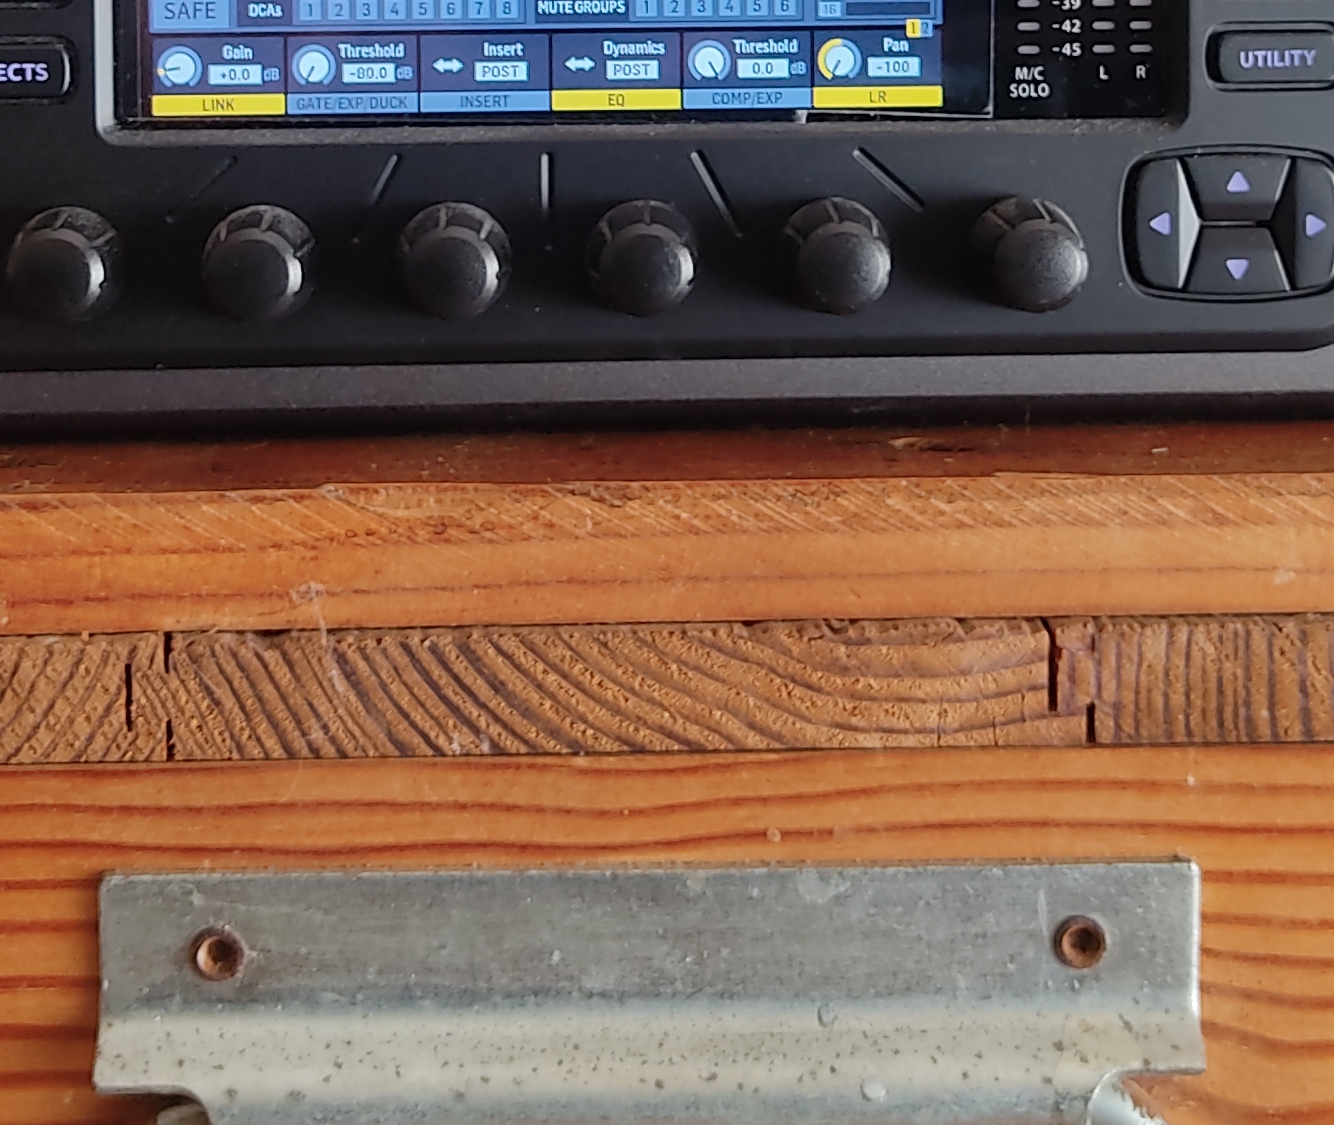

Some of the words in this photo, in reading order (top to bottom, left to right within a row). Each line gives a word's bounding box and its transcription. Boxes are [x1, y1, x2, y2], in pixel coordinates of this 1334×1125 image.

[164, 2, 216, 19] SAFE
[248, 4, 283, 19] DCAs
[537, 0, 572, 14] MUTE
[574, 0, 626, 14] GROUPS
[1052, 19, 1081, 33] -42
[222, 45, 253, 60] Gain
[338, 43, 405, 58] Threshold
[484, 42, 523, 57] Insert
[603, 41, 665, 57] Dynamics
[732, 39, 799, 54] Threshold
[883, 38, 909, 53] Pan
[1052, 42, 1081, 56] -45
[1240, 48, 1316, 67] UTILITY
[482, 65, 519, 77] POST
[613, 64, 650, 76] POST
[1015, 66, 1045, 80] M/C
[1100, 65, 1109, 80] L
[1136, 65, 1146, 79] R
[869, 91, 887, 103] LR
[1009, 84, 1050, 98] SOLO
[202, 98, 234, 112] LINK
[460, 95, 509, 107] INSERT
[608, 94, 625, 107] EQ
[712, 92, 782, 105] COMP/EXP
